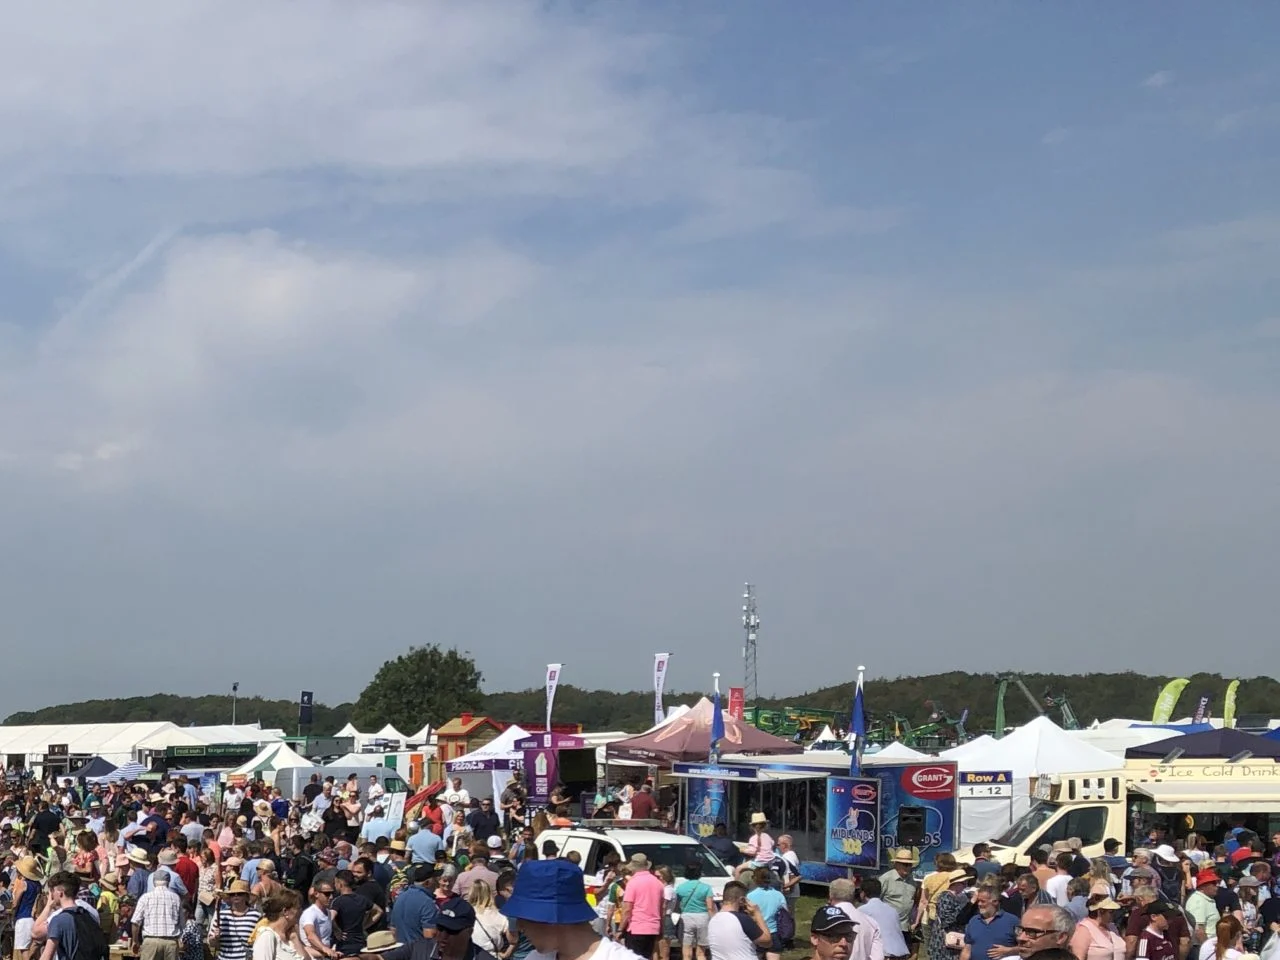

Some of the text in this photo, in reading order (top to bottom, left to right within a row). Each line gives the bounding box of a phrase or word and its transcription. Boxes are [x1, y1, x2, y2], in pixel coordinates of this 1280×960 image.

[1168, 764, 1280, 777] Ice Cold Drink
[966, 773, 1006, 783] Row A
[968, 787, 975, 795] 1
[987, 786, 1002, 795] 12
[831, 827, 875, 842] MIDLANDS
